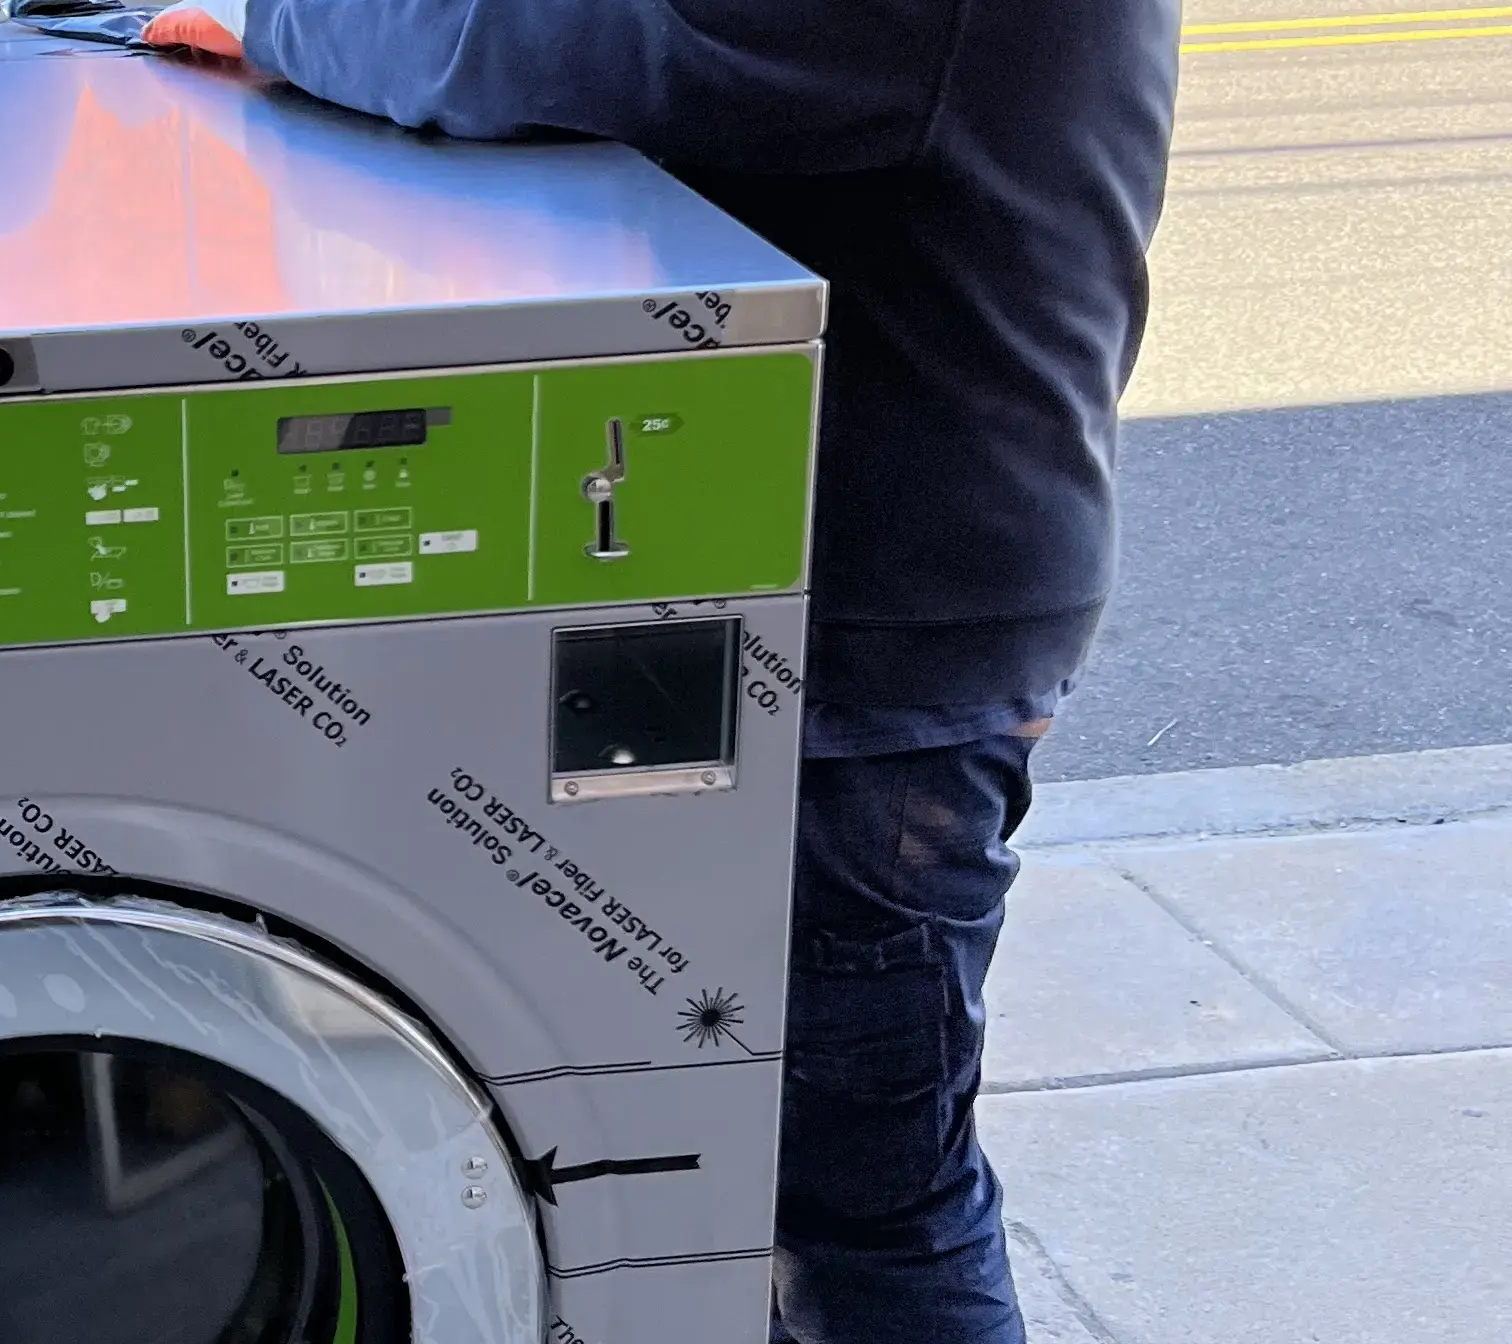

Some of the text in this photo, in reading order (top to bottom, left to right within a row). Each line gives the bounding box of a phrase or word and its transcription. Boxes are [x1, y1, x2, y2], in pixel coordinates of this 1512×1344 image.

[234, 649, 248, 665] &
[248, 658, 313, 717] LASER
[283, 645, 370, 725] Solution
[428, 788, 512, 864] Solution
[484, 796, 546, 852] LASER
[544, 845, 559, 861] &
[554, 859, 604, 902] Fiber
[602, 896, 663, 951] LASER
[628, 957, 664, 995] The
[658, 947, 689, 973] for
